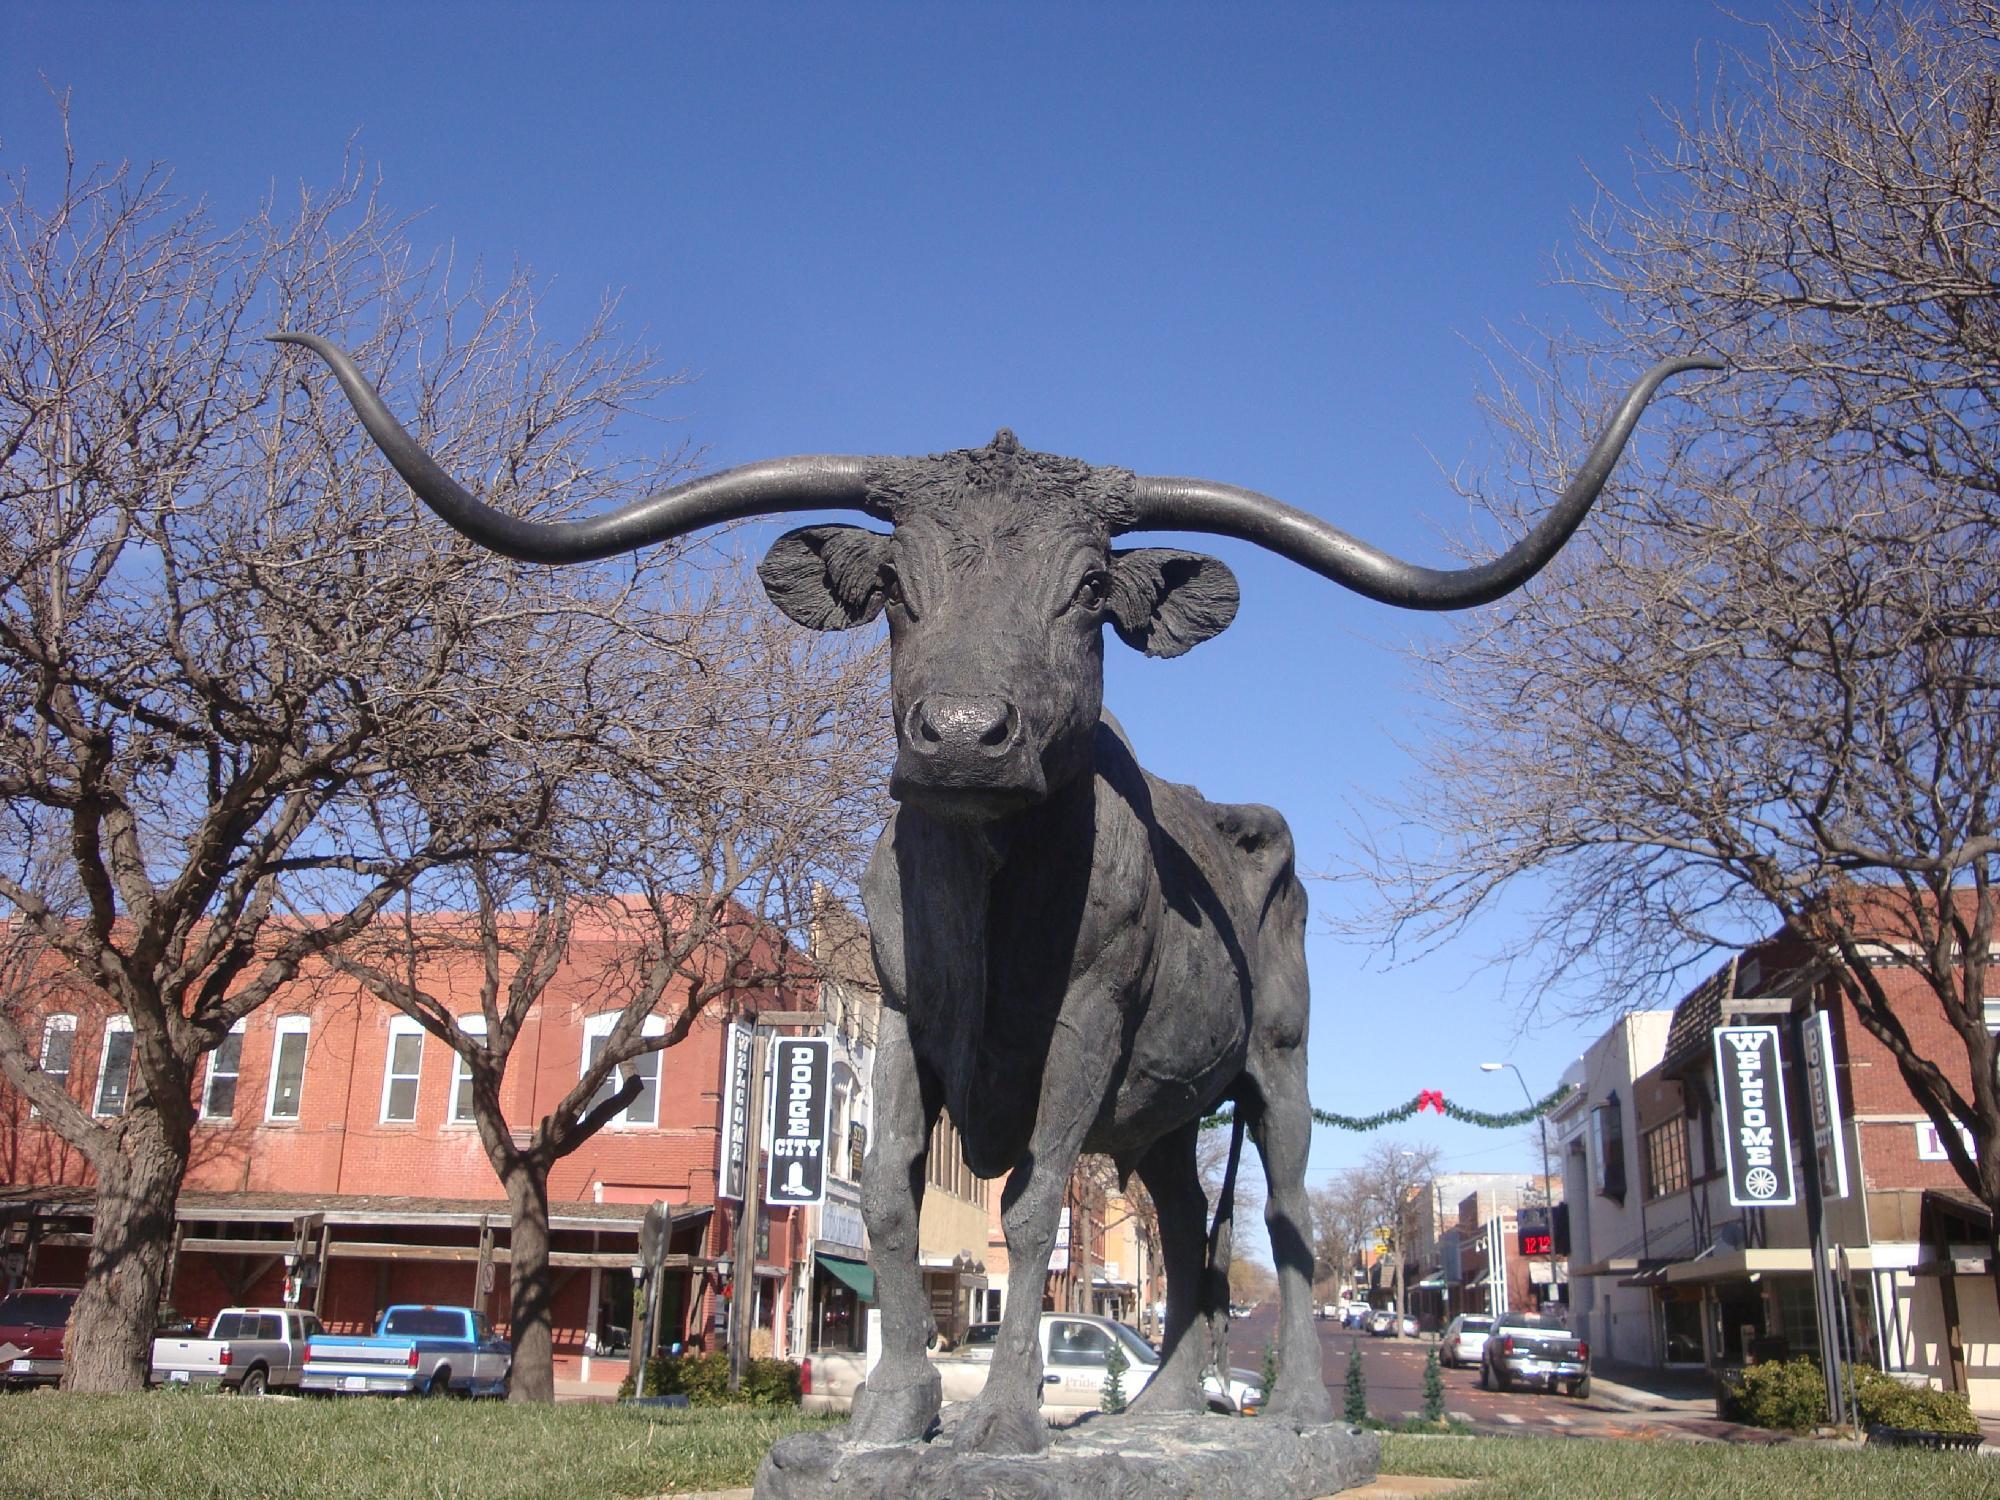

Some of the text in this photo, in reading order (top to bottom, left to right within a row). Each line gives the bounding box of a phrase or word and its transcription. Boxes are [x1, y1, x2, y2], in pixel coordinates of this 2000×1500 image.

[731, 1031, 750, 1161] WELCOME
[788, 1047, 814, 1137] DODGE
[1725, 1032, 1774, 1166] WELCOME
[1807, 1028, 1828, 1125] DODGE
[774, 1139, 821, 1157] CITY
